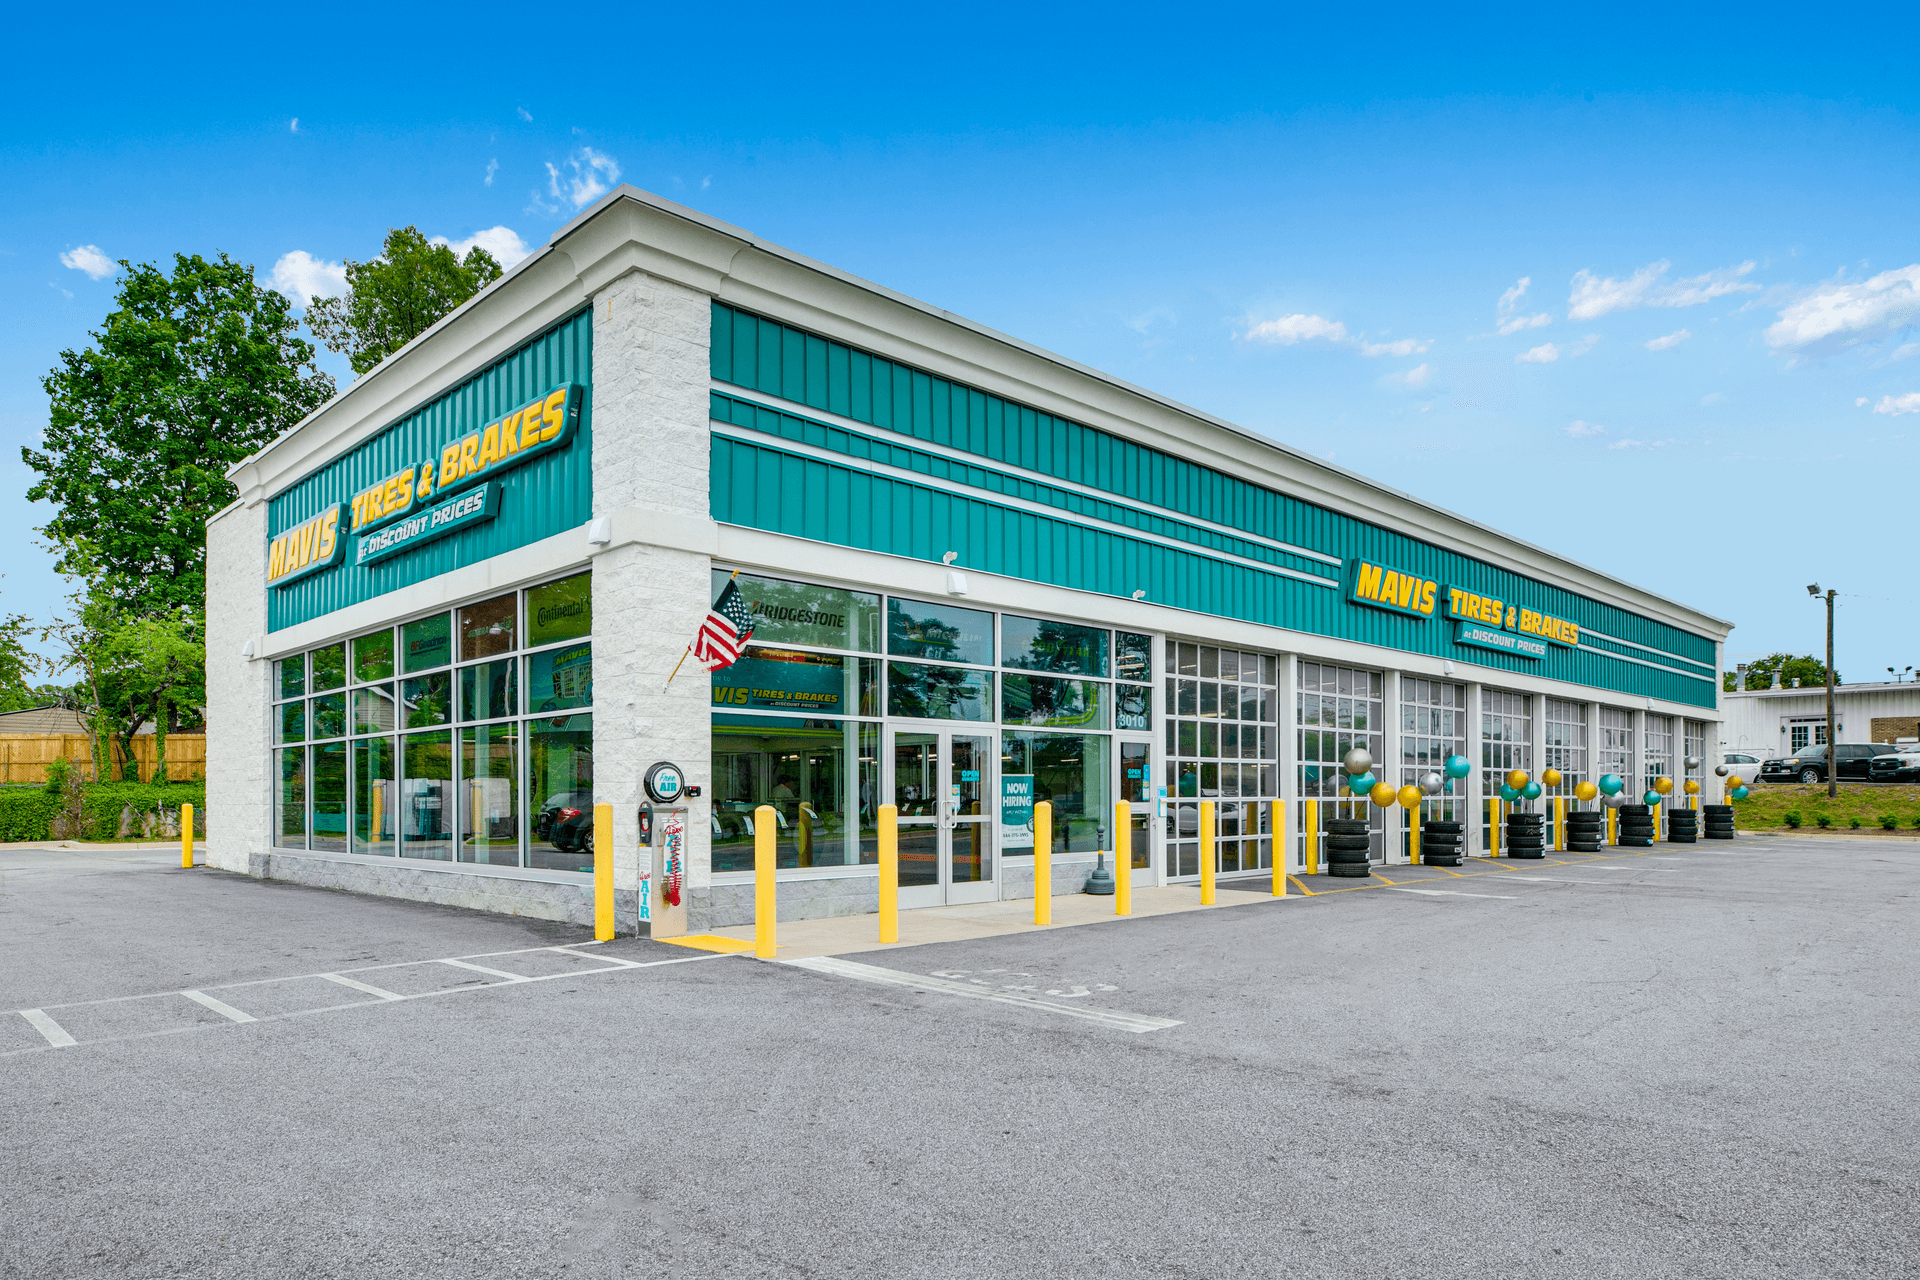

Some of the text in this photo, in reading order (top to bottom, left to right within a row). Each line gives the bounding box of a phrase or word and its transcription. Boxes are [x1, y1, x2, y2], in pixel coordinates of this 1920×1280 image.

[268, 388, 567, 581] MAVIS TIRES & BRAKES
[369, 514, 429, 553] DISCOUNT
[431, 491, 484, 529] PRICES
[537, 598, 584, 627] Continental
[752, 601, 845, 628] BRIDGESTONE
[1356, 562, 1579, 645] MAVIS TIRES & BRAKES
[1472, 629, 1515, 648] DISCOUNT
[1517, 639, 1545, 655] PRICES
[555, 646, 590, 666] MAVIS
[711, 686, 838, 705] VIS TIRES & BRAKES
[1119, 714, 1145, 728] 3010
[659, 772, 676, 782] Free
[660, 782, 677, 792] AIR
[1006, 783, 1028, 794] NOW
[1003, 796, 1032, 807] HIRING
[640, 880, 650, 919] AIR
